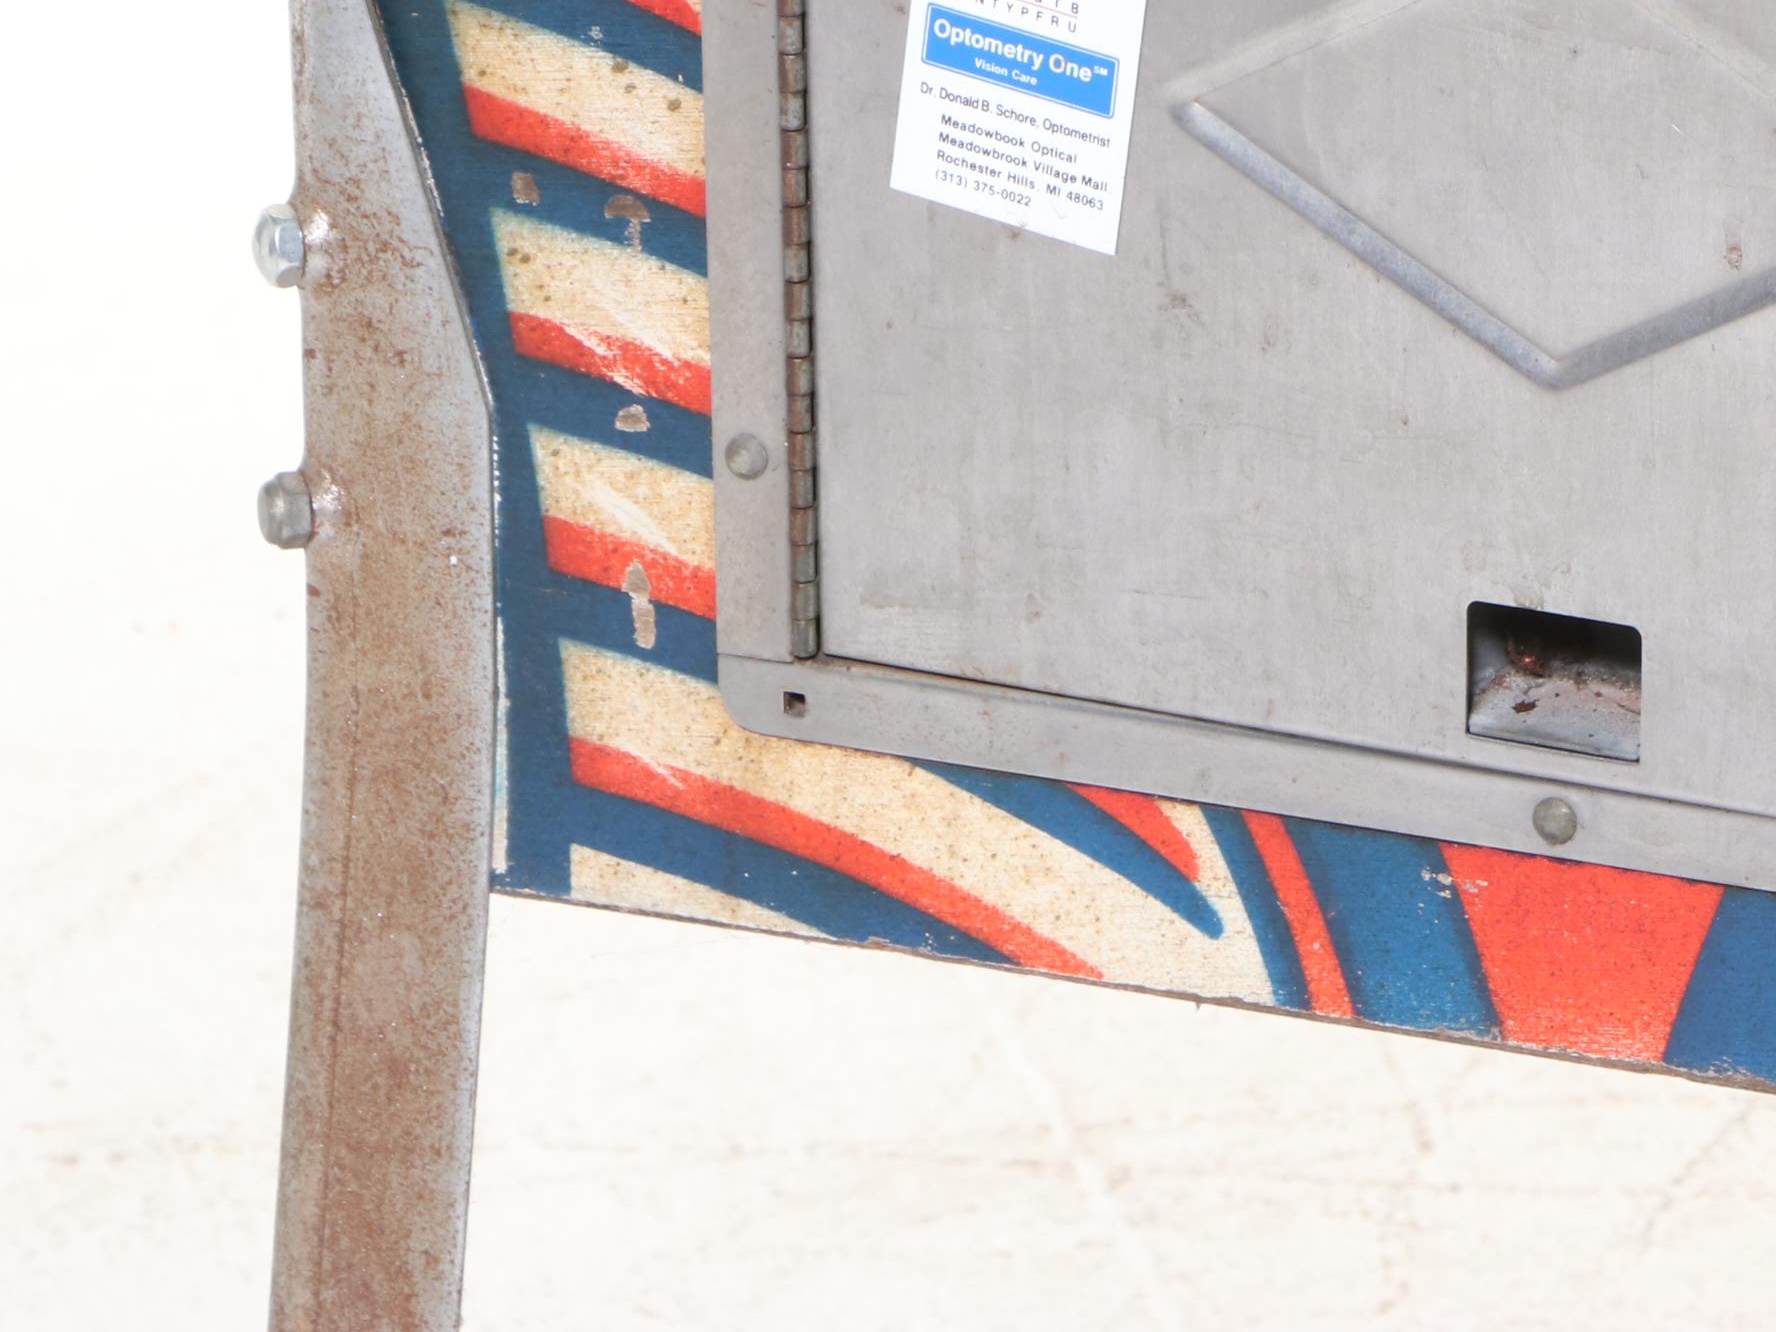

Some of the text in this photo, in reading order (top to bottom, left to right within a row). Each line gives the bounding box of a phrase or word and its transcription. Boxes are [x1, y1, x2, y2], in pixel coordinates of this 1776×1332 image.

[933, 19, 1044, 70] Optometry
[974, 57, 1038, 86] Vision Care
[939, 87, 979, 110] Donald
[1042, 118, 1111, 149] Optometrist
[940, 114, 1077, 164] Meadowbook Optical
[936, 150, 1002, 179] Rochester
[1046, 183, 1061, 197] MI
[1066, 191, 1104, 211] 48063
[939, 131, 1028, 168] Meadowbrook
[1033, 160, 1078, 184] Village
[935, 169, 1031, 207] (313) 375-0022
